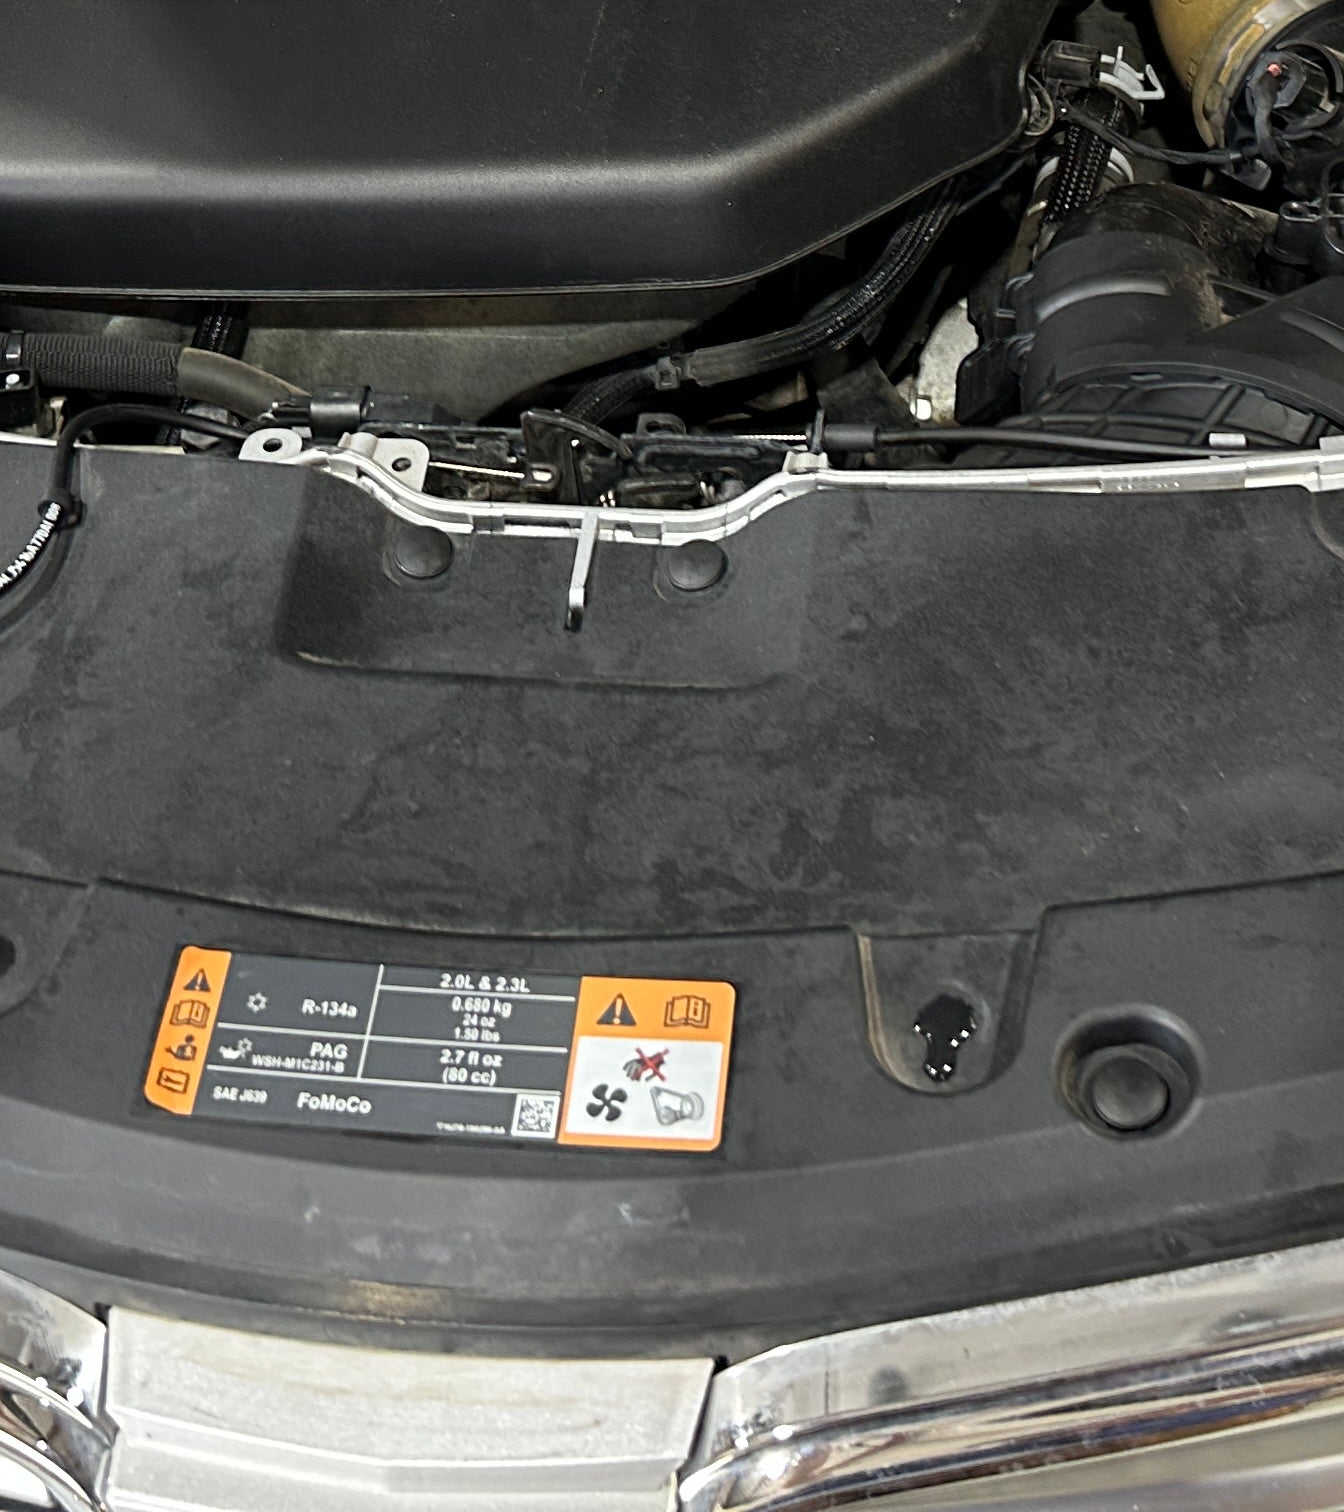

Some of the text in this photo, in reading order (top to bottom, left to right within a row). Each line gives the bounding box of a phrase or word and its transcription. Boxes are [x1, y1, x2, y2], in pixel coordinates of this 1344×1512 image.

[440, 972, 531, 993] 2.0L & 2.3L
[301, 998, 358, 1018] R-134a
[493, 998, 512, 1018] kg
[480, 1016, 496, 1028] oz
[310, 1041, 348, 1060] PAG
[440, 1048, 466, 1065] 2.7
[482, 1054, 503, 1068] oz
[470, 1069, 497, 1088] cc)
[212, 1085, 239, 1102] SAE
[297, 1091, 373, 1115] FoMoCo
